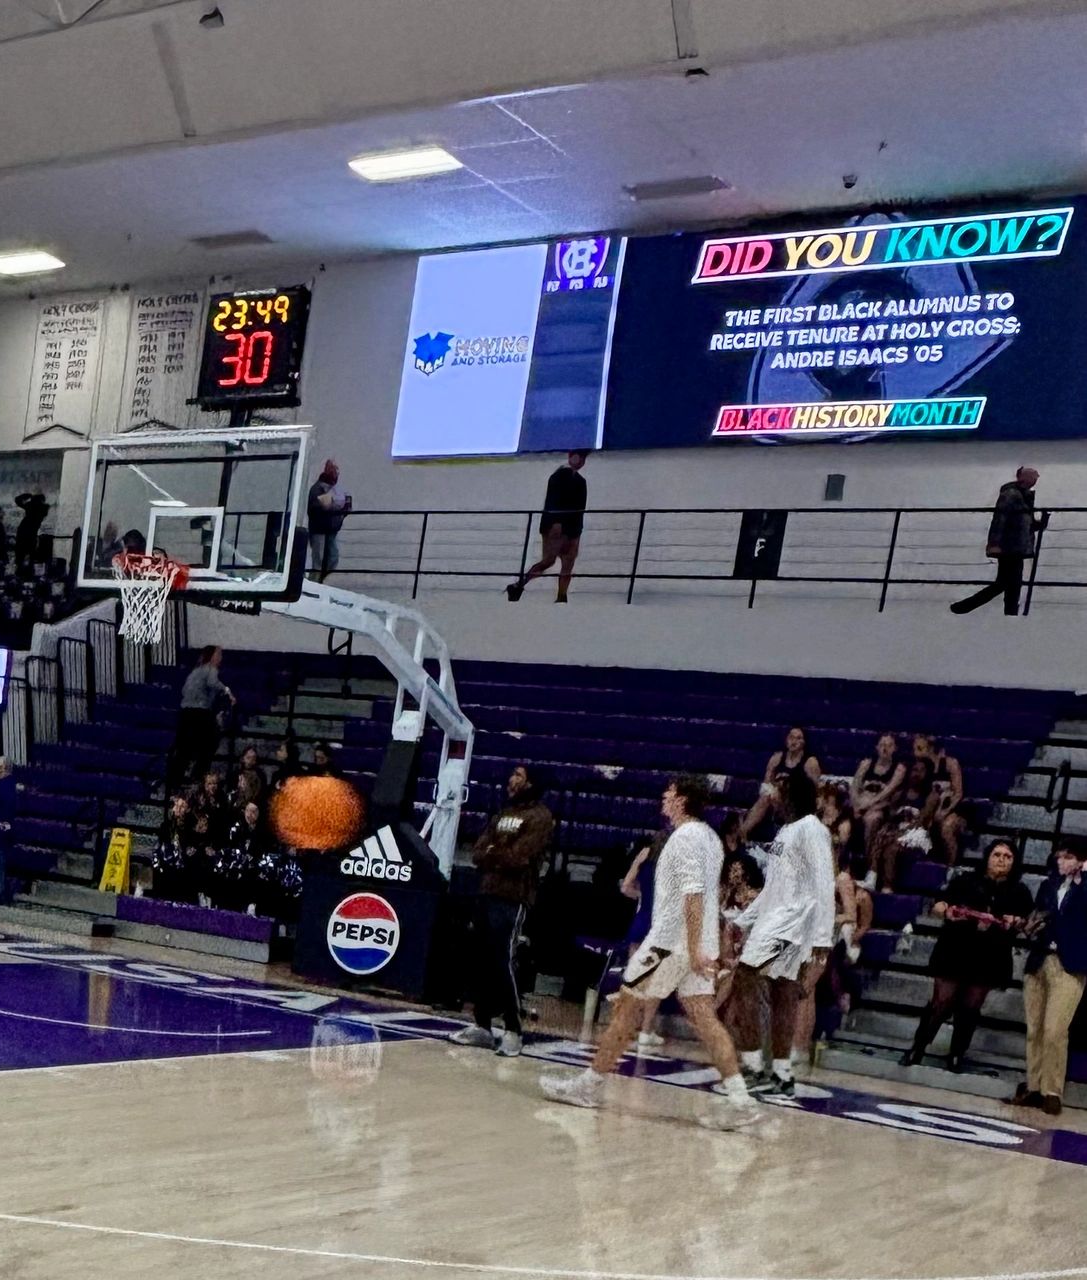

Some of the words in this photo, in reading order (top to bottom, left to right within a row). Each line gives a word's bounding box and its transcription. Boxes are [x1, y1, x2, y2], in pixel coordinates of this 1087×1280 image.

[701, 241, 774, 277] DID
[784, 230, 878, 269] YOU
[884, 214, 1064, 263] KNOW?
[213, 295, 290, 332] 23:49
[725, 309, 761, 327] THE
[763, 305, 814, 324] FIRST
[818, 300, 881, 321] BLACK
[884, 294, 982, 317] ALUMNUS
[986, 292, 1015, 311] TO
[710, 331, 784, 351] RECEIVE
[787, 325, 859, 347] TENURE
[861, 323, 888, 341] AT
[891, 320, 944, 340] HOLY
[946, 316, 1021, 337] CROSS:
[218, 331, 274, 386] 30
[452, 355, 475, 366] AND
[477, 353, 527, 365] STORAGE
[770, 348, 834, 369] ANDRE
[838, 346, 909, 366] ISAACS
[914, 344, 944, 363] '05
[340, 856, 412, 882] adidas
[331, 921, 396, 946] PEPSI
